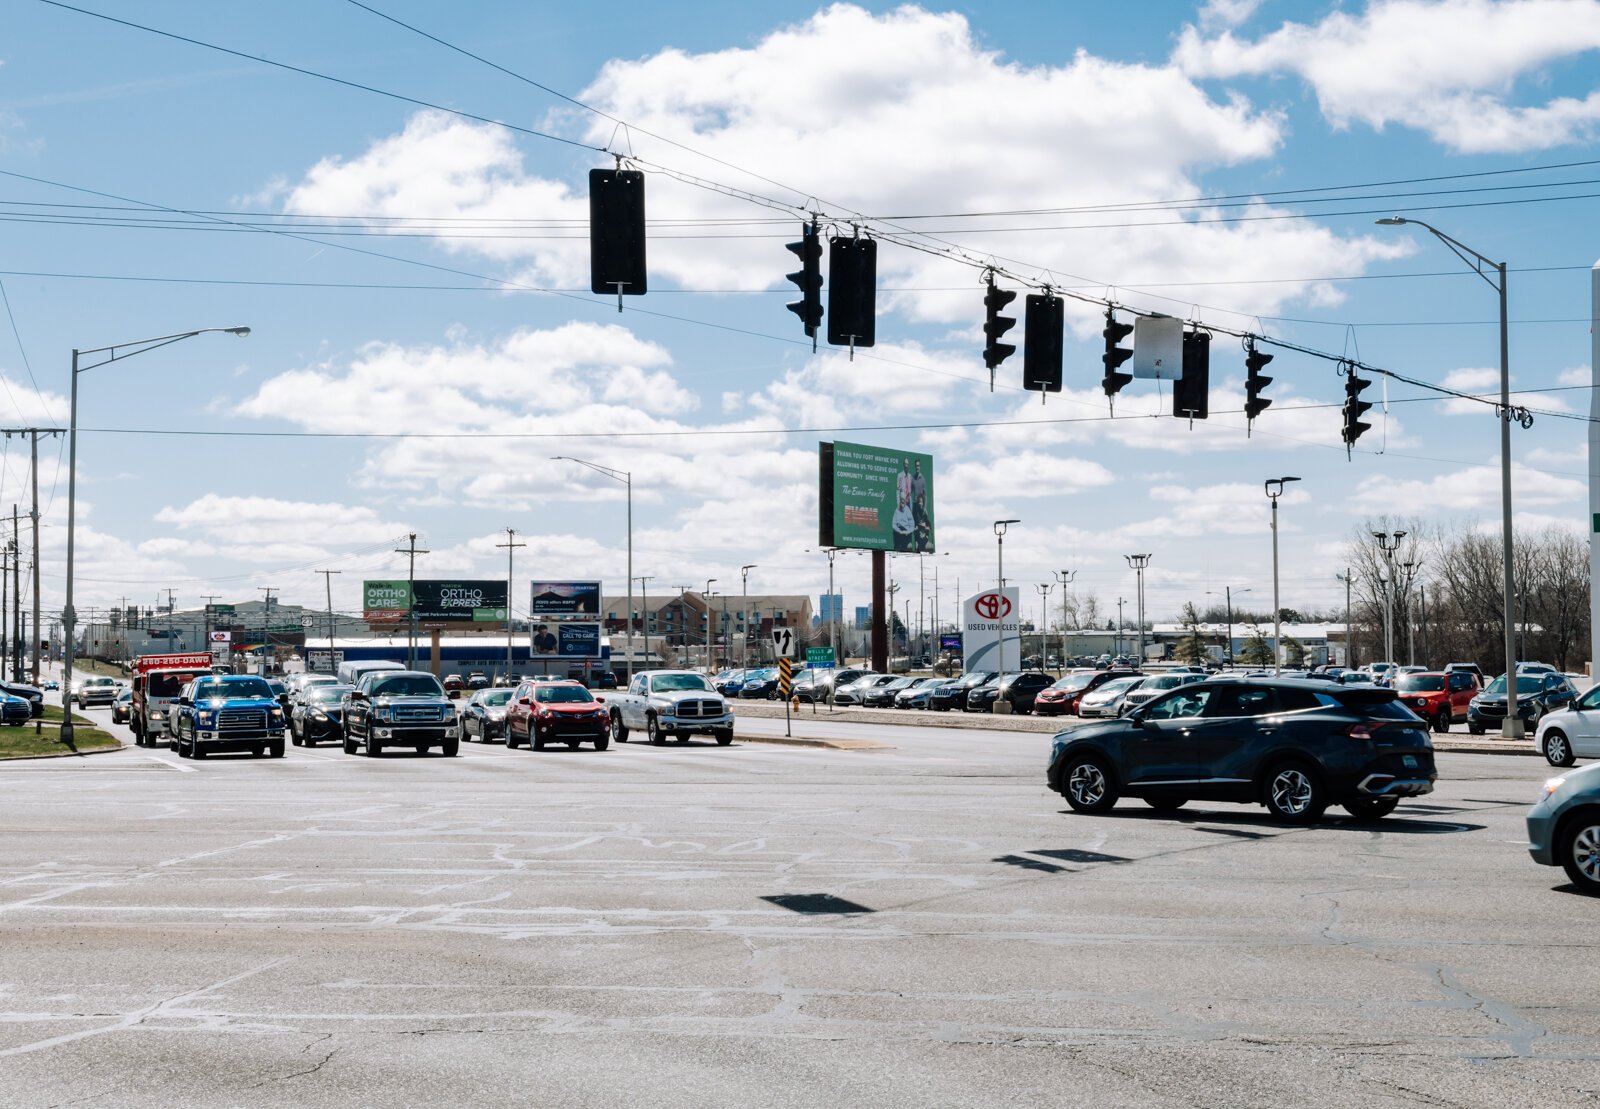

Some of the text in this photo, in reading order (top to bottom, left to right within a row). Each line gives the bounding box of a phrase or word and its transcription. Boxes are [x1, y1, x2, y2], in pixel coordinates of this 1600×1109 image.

[837, 450, 852, 458] THANK
[874, 455, 889, 463] WAYNE
[837, 460, 860, 469] ALLOWING
[874, 465, 887, 473] SERVE
[837, 470, 863, 479] COMMUNITY
[842, 485, 851, 495] The
[867, 488, 886, 502] Family
[368, 589, 407, 598] ORTHO
[440, 588, 483, 599] ORTHO
[368, 598, 400, 607] CARE
[440, 599, 482, 609] EXPRESS
